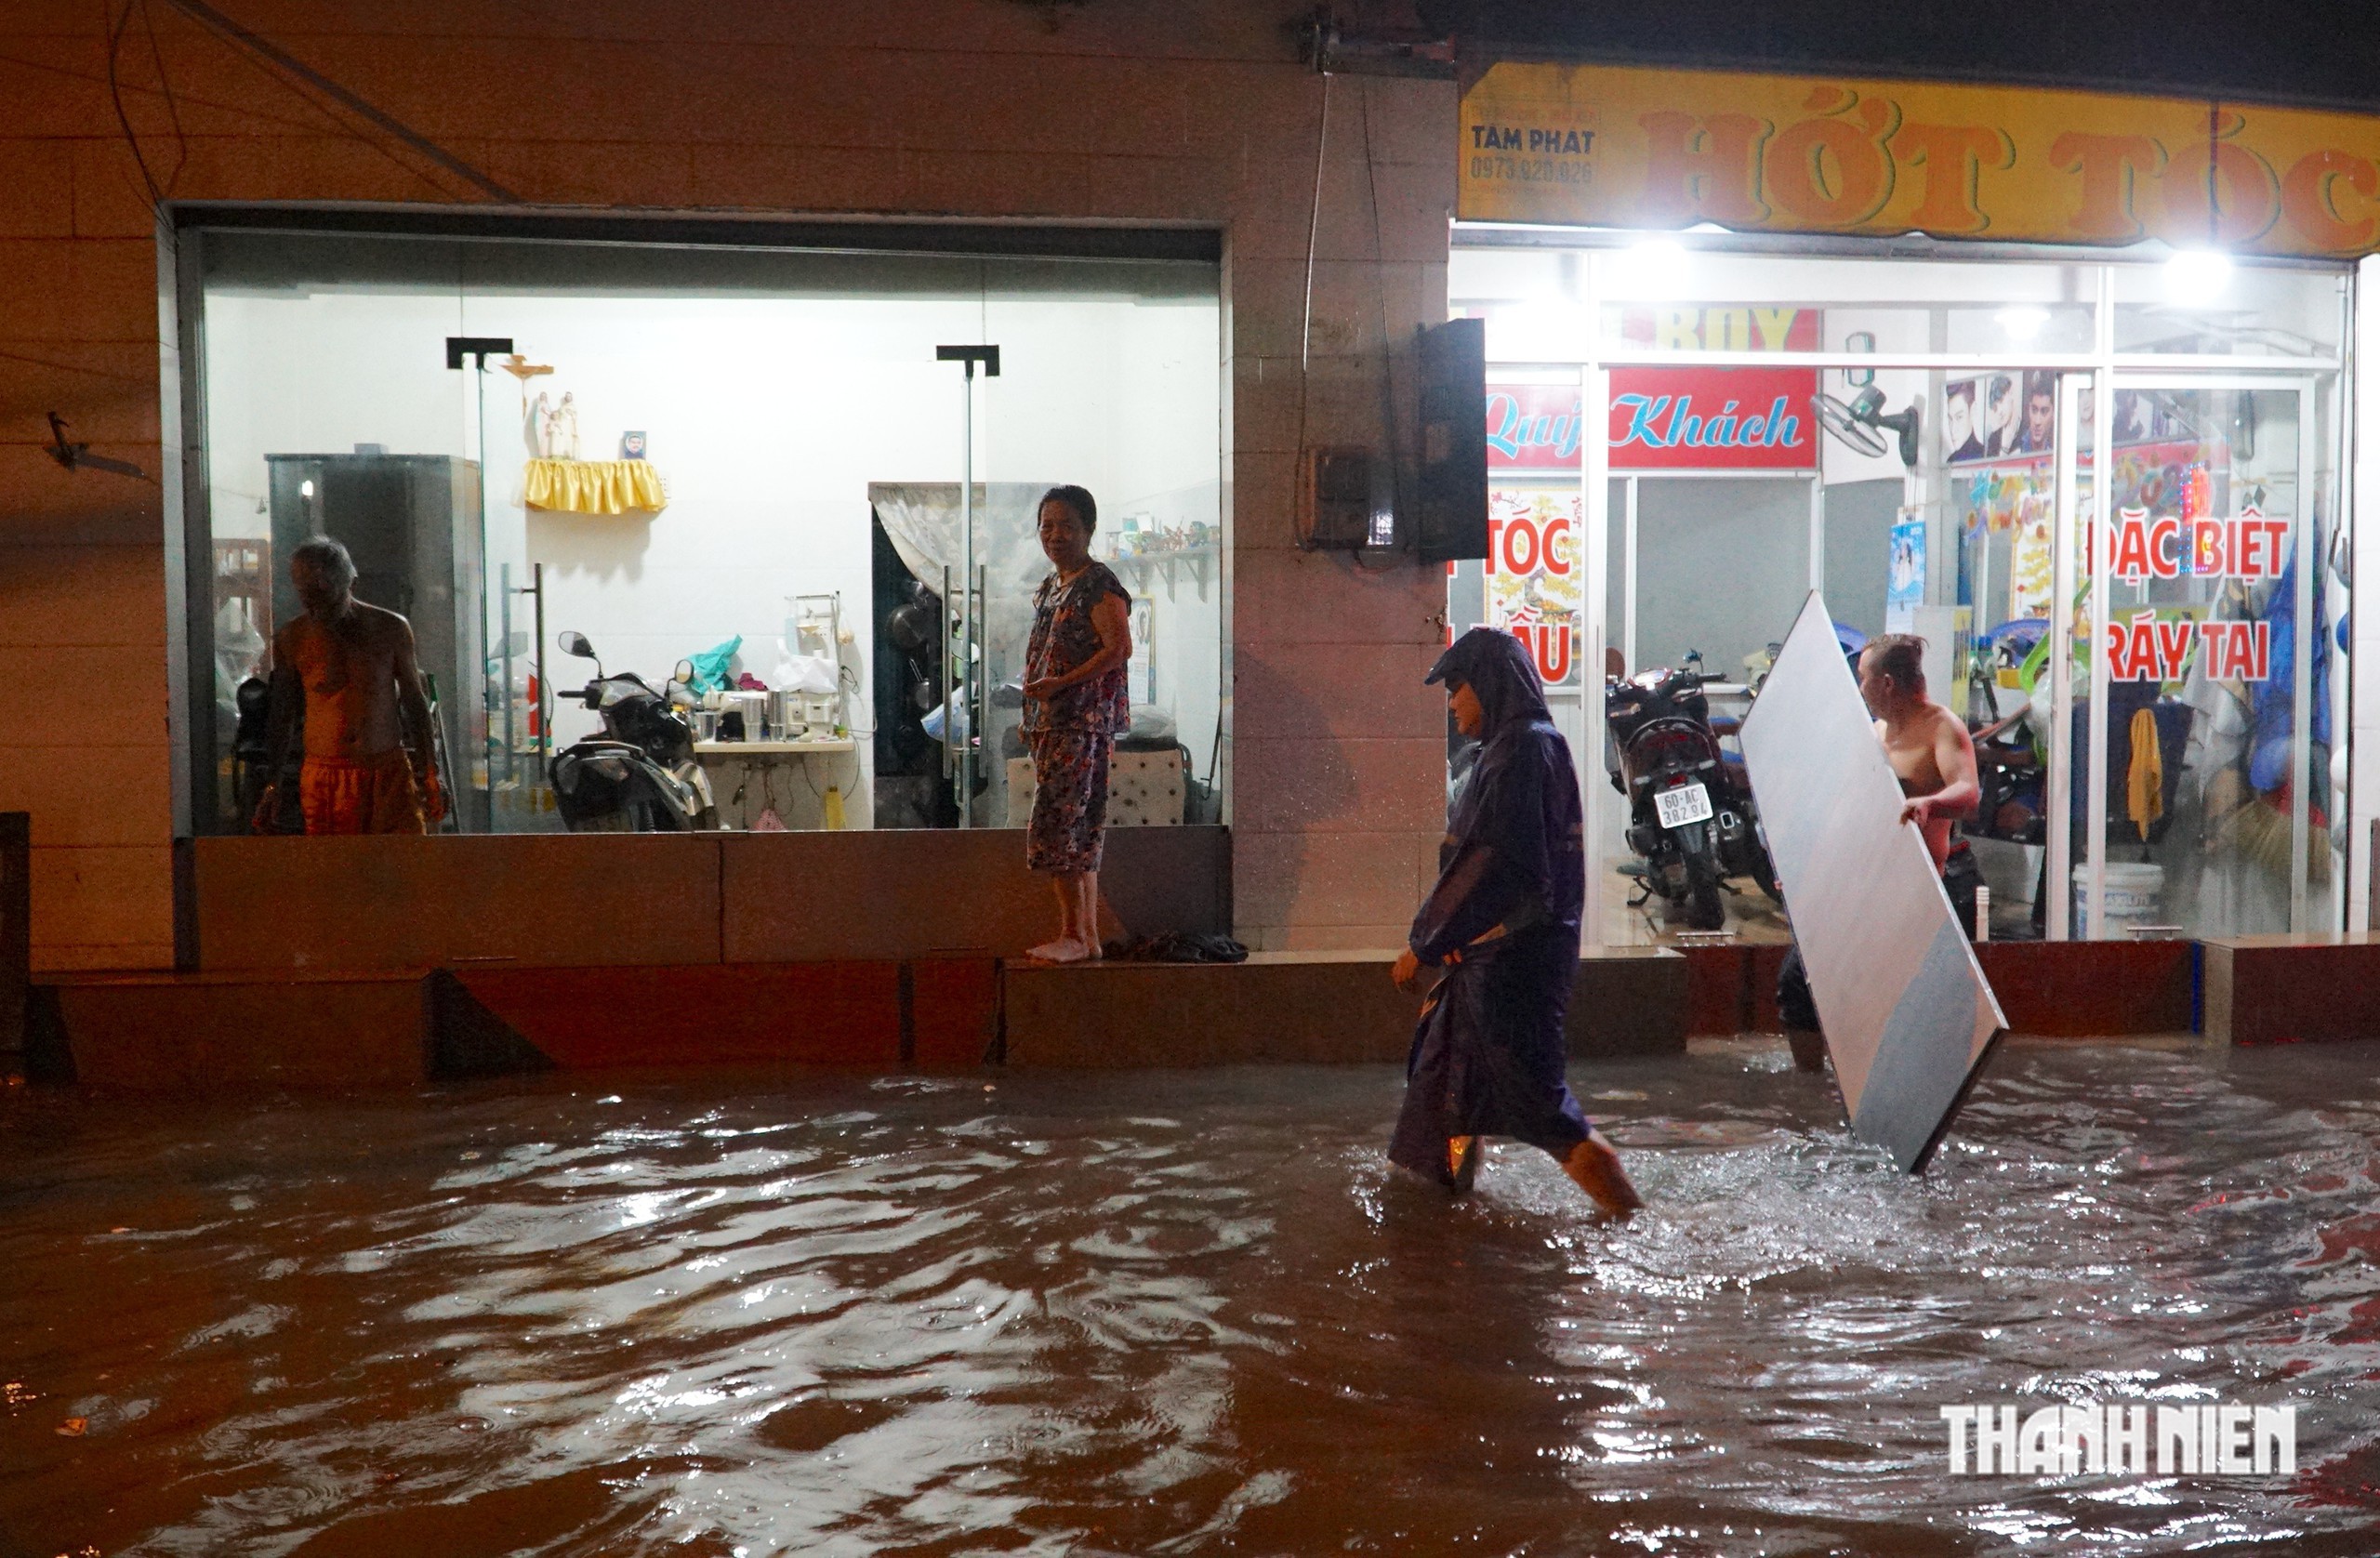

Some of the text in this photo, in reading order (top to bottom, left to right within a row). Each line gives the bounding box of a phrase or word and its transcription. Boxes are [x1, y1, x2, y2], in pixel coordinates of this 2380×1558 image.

[1639, 86, 2016, 231] HỚT
[1607, 394, 1804, 449] Khách
[2193, 508, 2291, 586] BIỆT
[2107, 609, 2269, 681] RÁY TAI
